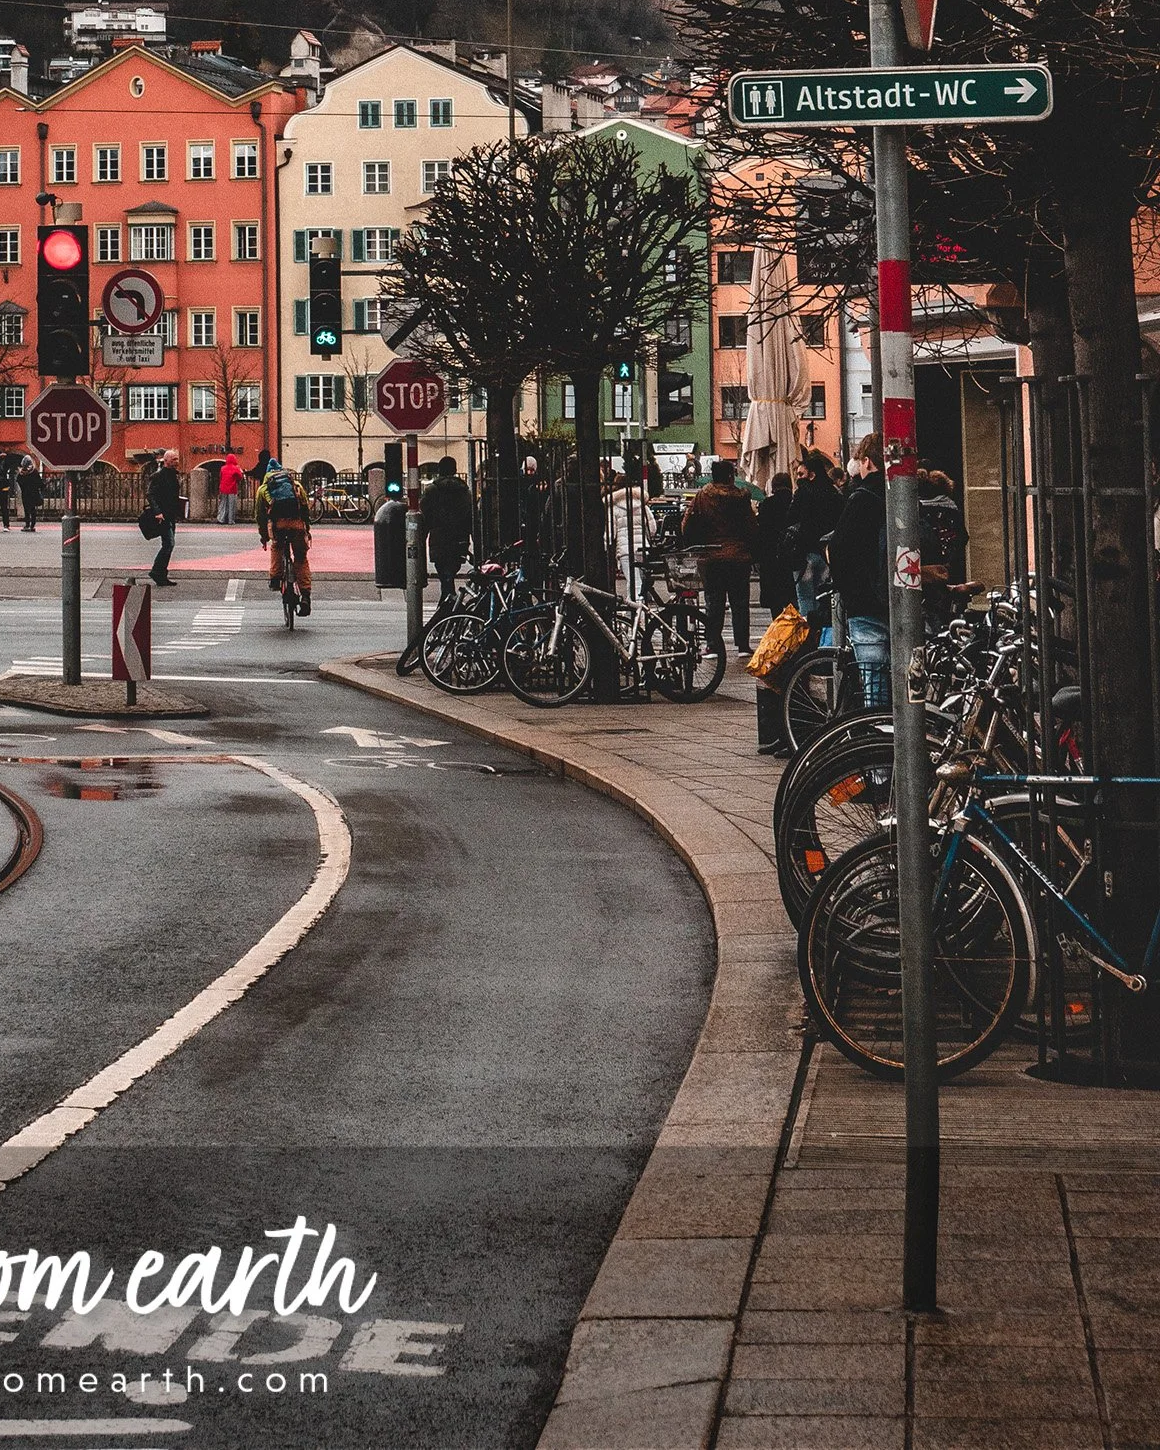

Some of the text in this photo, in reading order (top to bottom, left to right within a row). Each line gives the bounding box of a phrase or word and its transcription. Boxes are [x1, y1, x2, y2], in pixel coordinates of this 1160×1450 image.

[797, 80, 977, 111] Altstadt-WC
[383, 382, 440, 410] STOP
[37, 412, 101, 443] STOP
